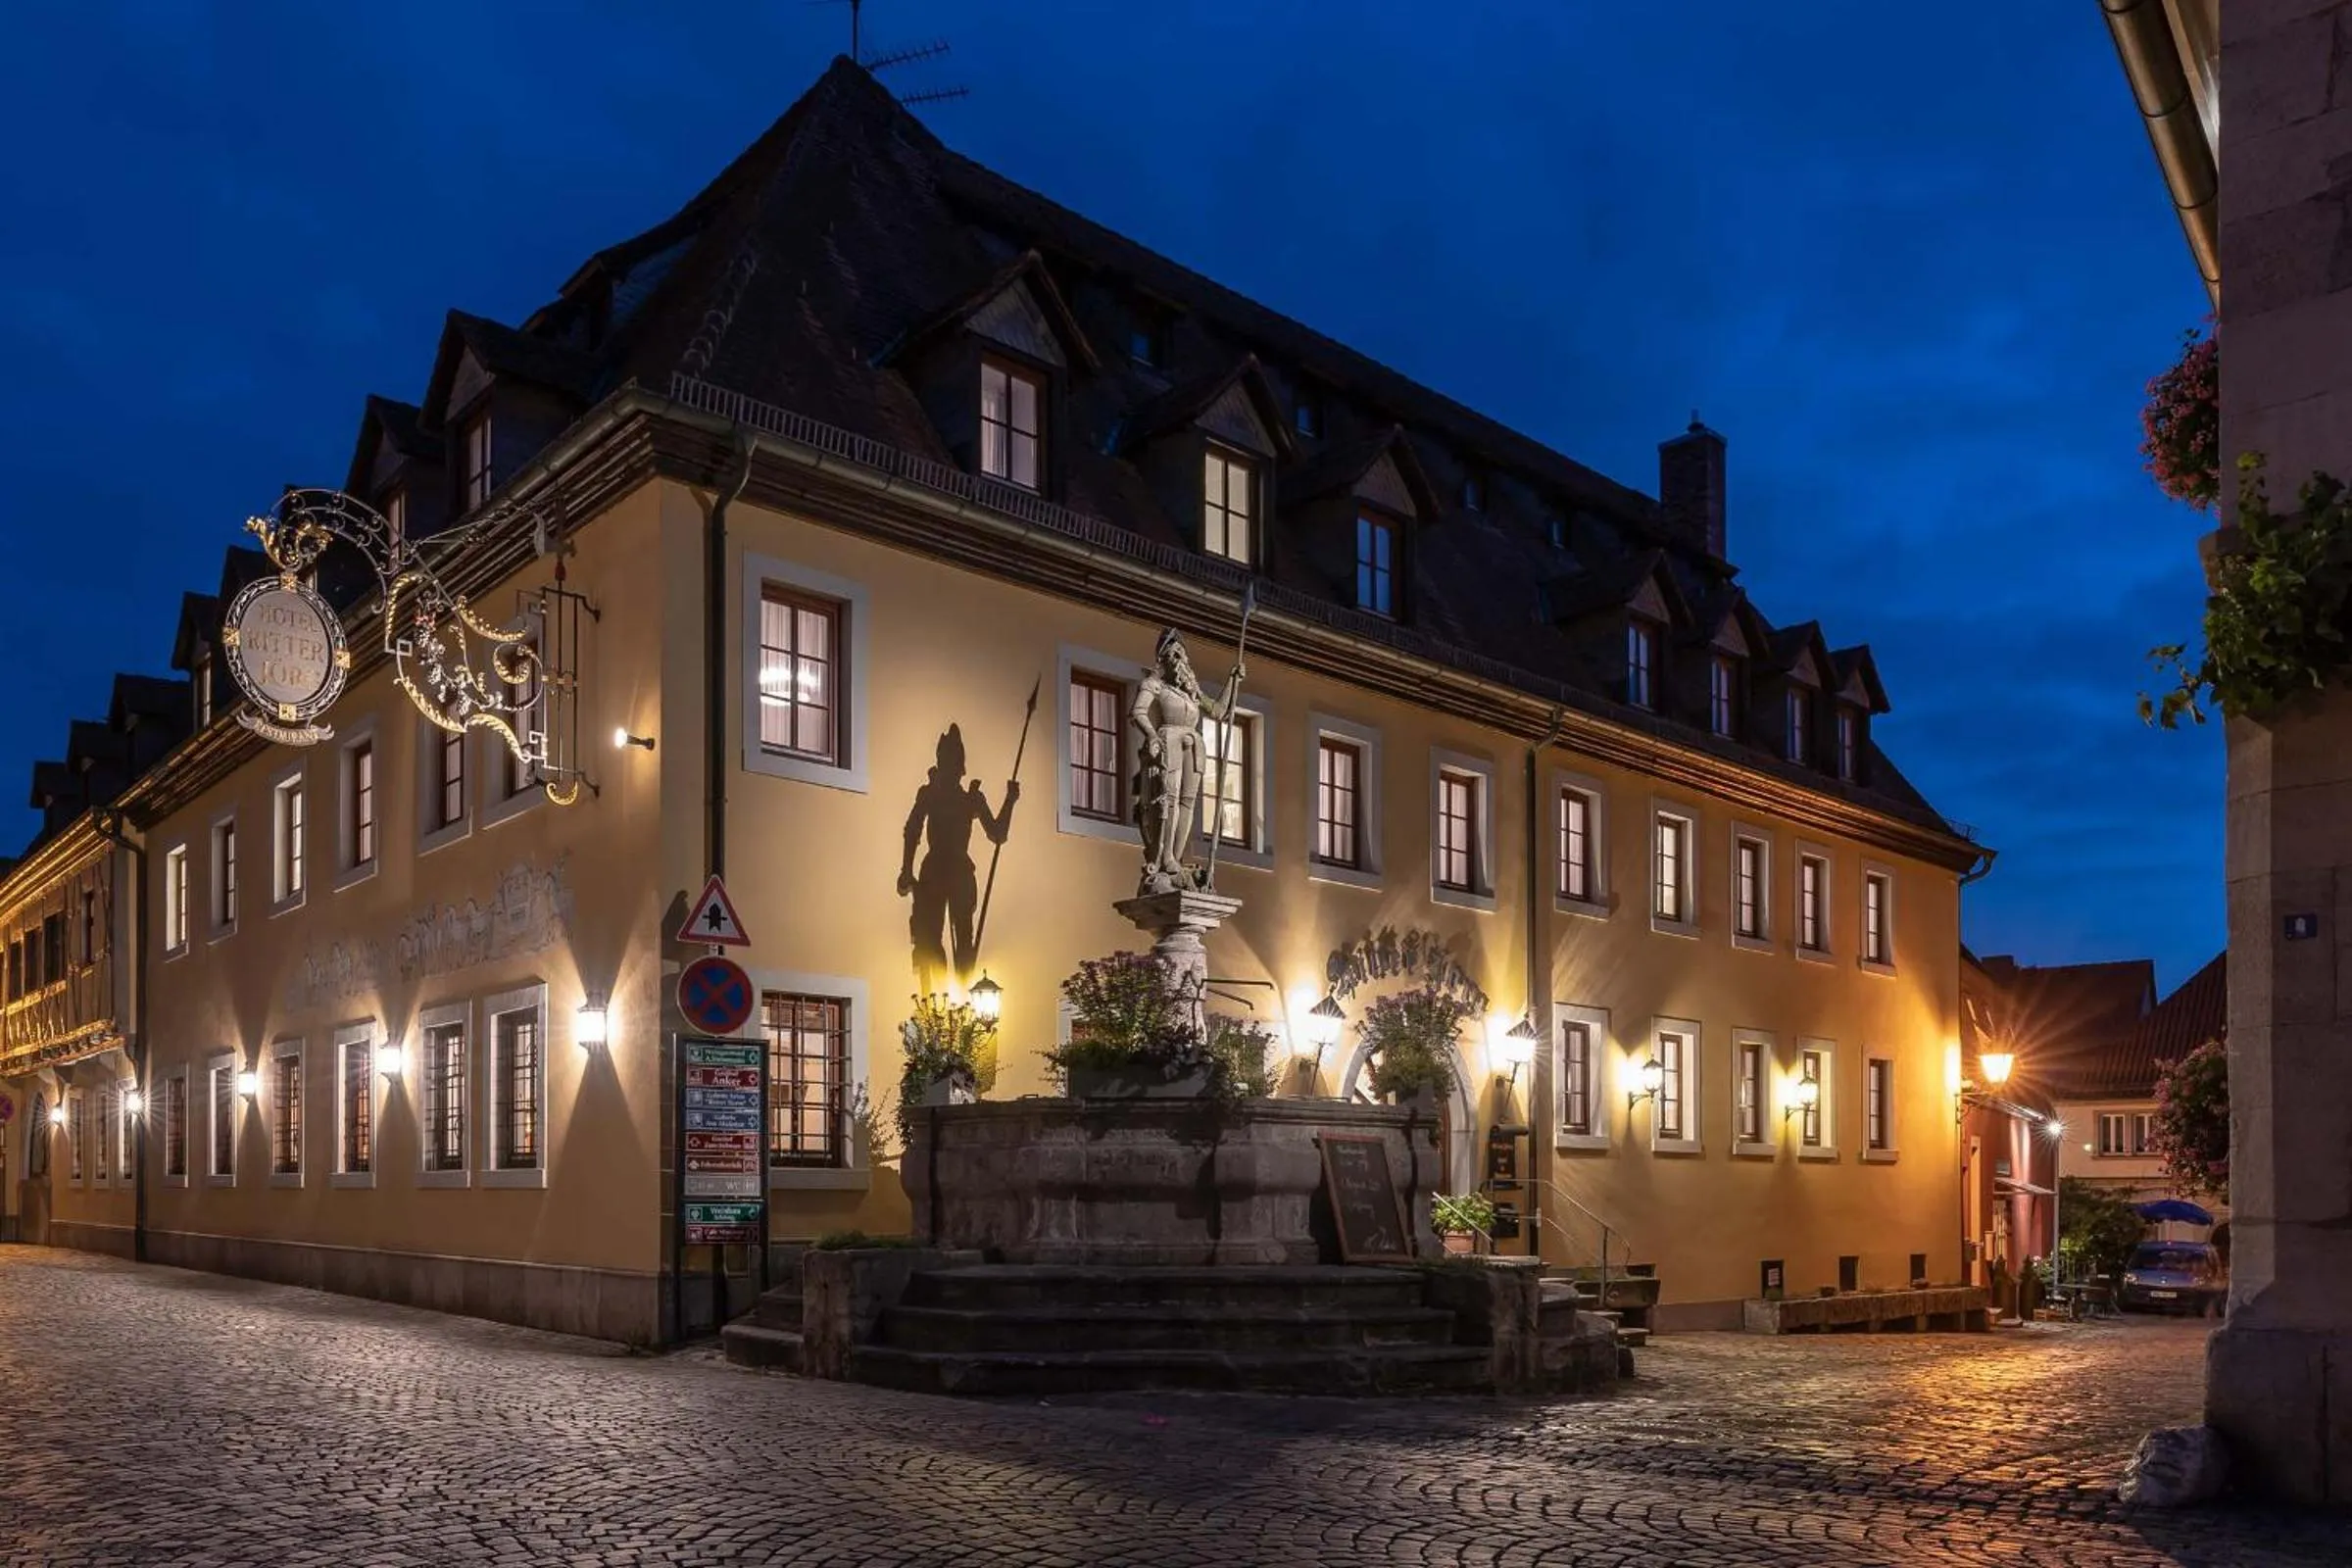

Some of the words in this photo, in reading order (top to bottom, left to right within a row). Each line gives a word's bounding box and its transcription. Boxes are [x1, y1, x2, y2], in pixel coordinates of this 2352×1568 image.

[259, 603, 321, 634] HOTEL
[247, 632, 324, 663] RITTER
[711, 1076, 741, 1087] Anker
